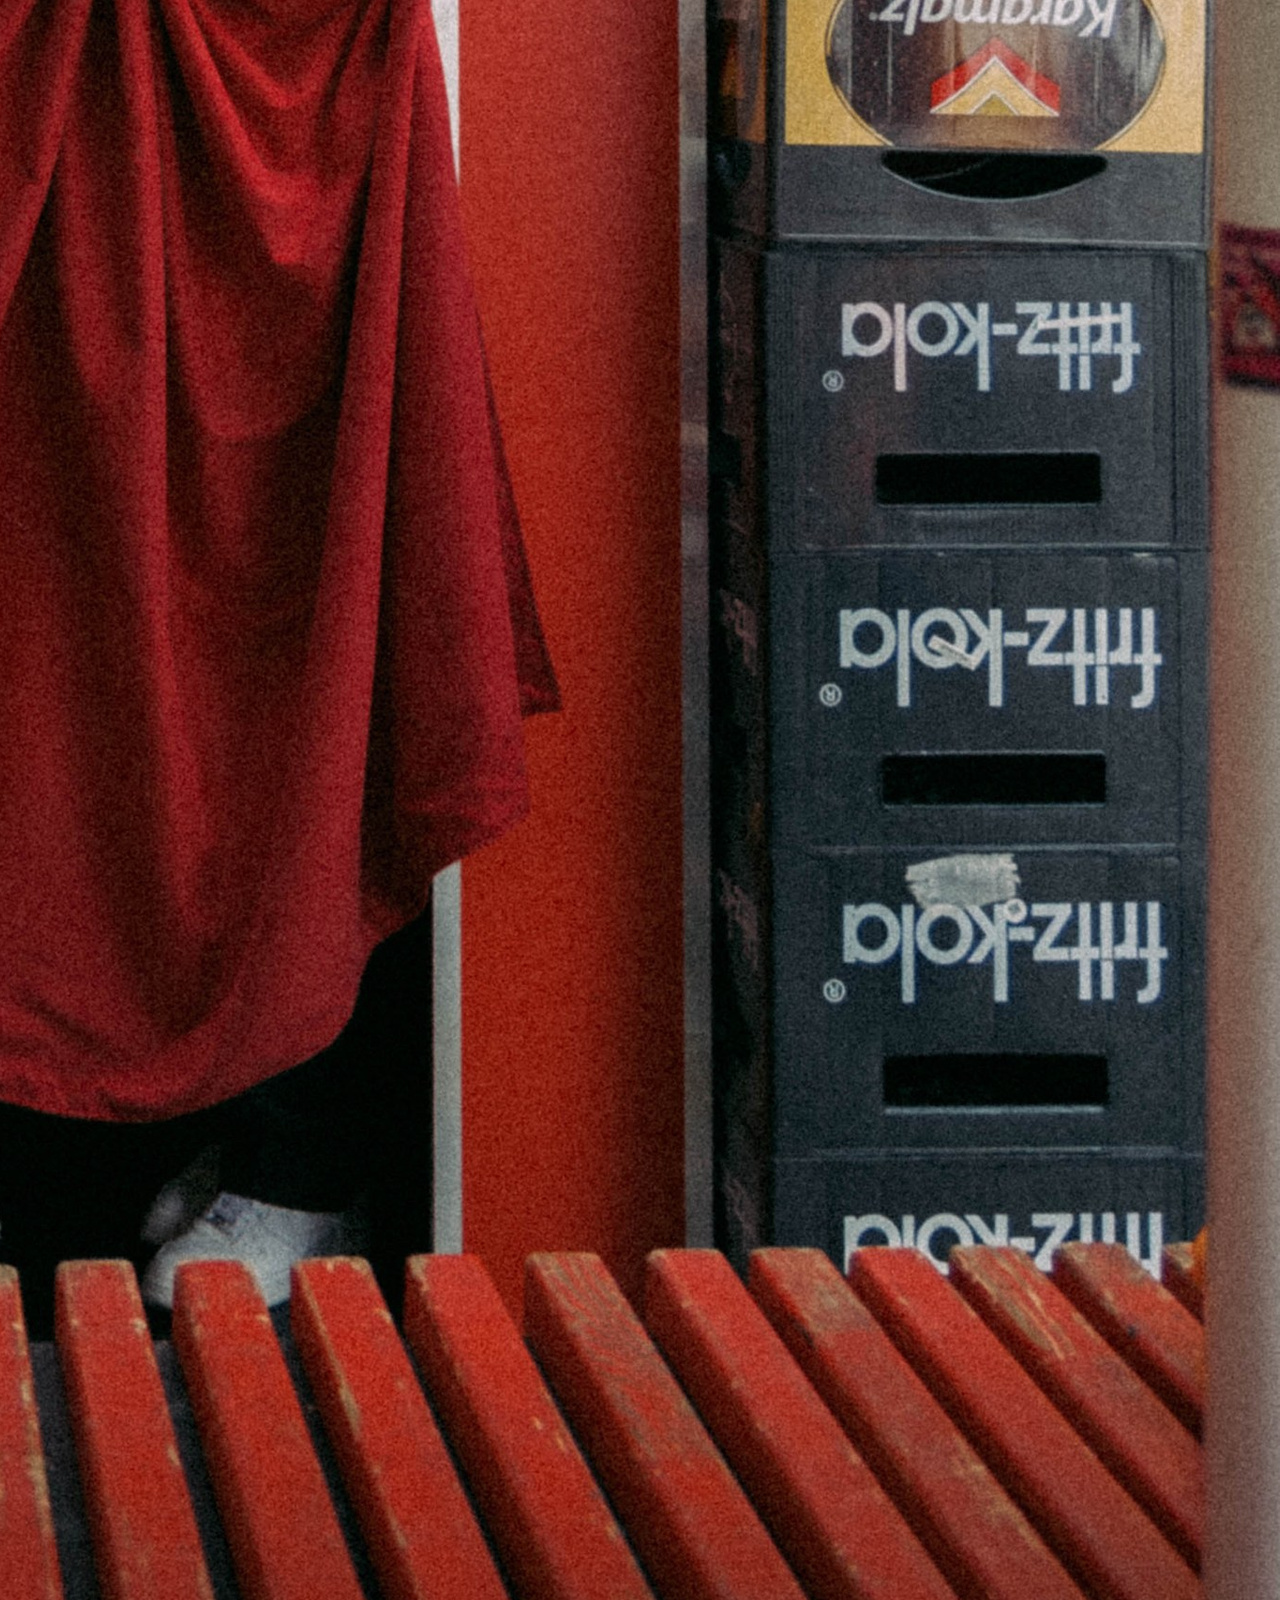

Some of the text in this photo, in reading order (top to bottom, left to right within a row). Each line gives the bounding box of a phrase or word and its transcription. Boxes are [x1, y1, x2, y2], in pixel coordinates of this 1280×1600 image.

[841, 301, 1141, 393] fritz-kola
[839, 607, 1163, 709] fritz-kola
[842, 901, 1169, 1004] fritz-kola
